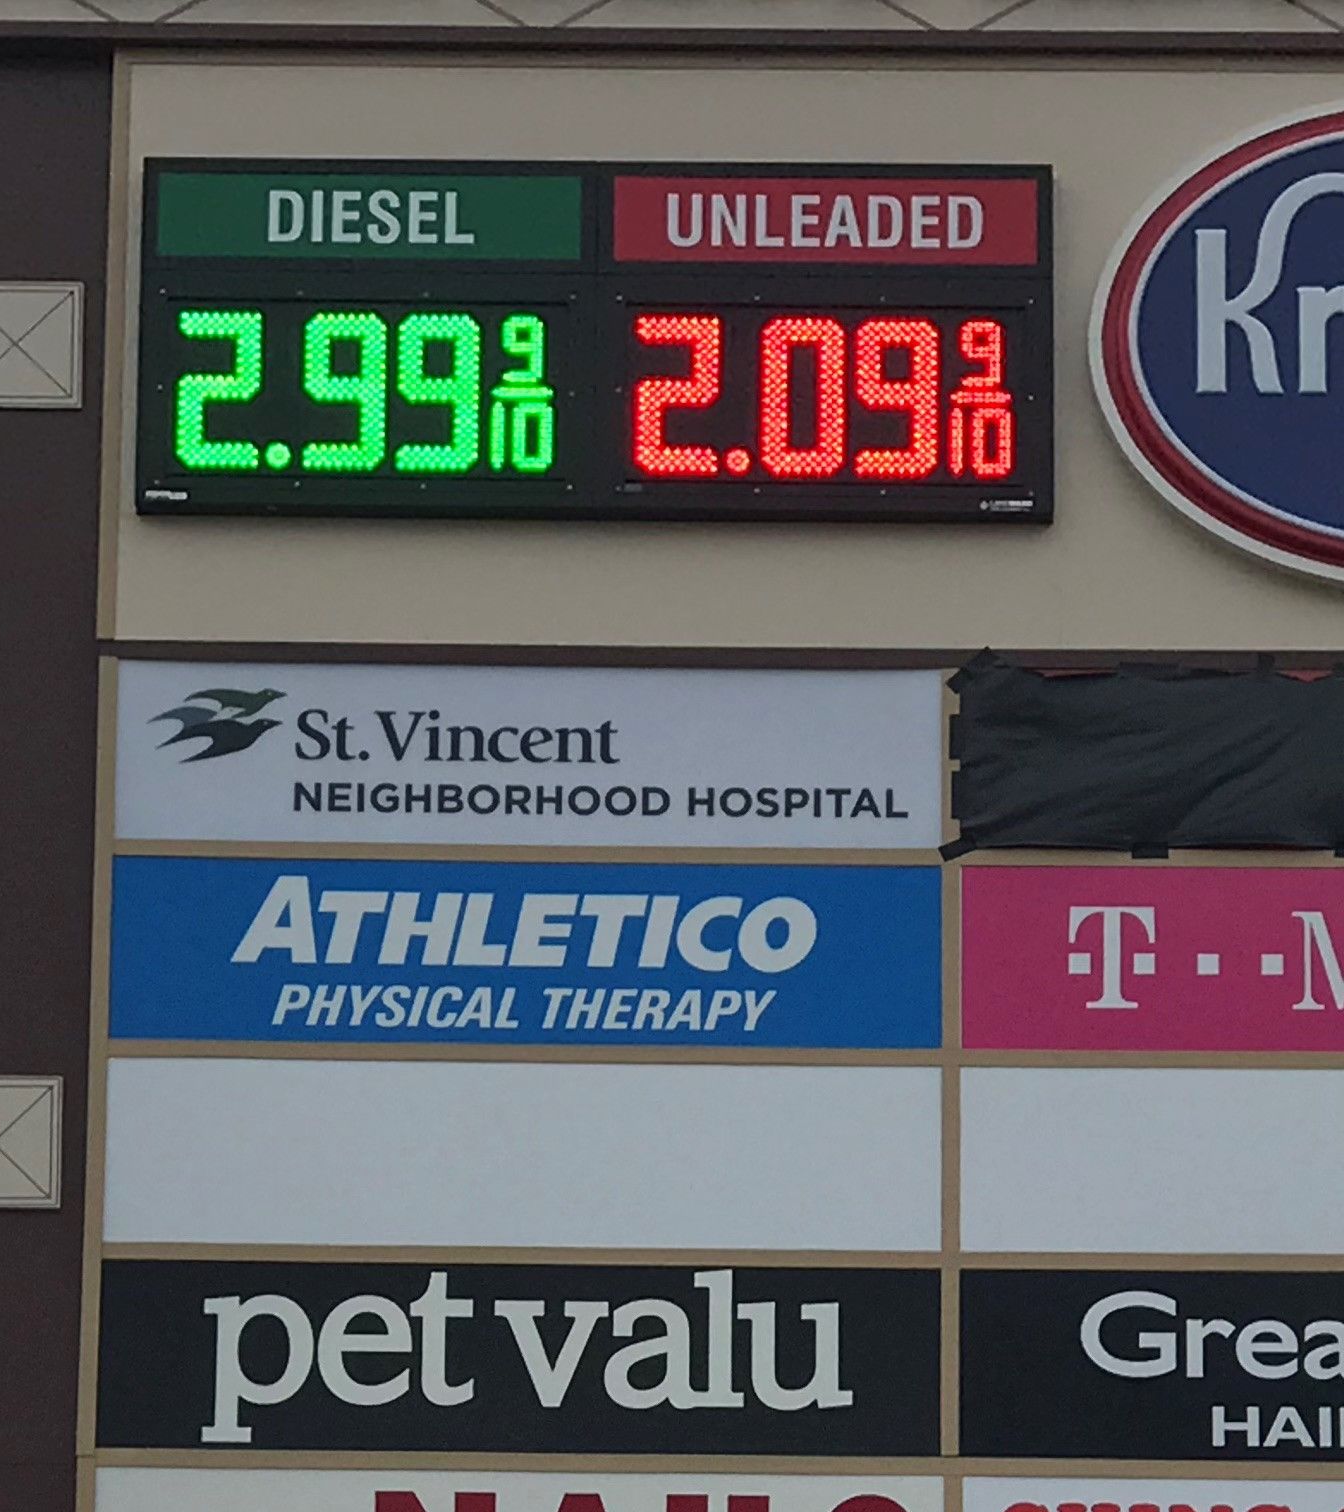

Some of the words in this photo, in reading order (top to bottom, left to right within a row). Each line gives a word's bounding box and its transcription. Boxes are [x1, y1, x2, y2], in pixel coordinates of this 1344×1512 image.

[267, 189, 475, 244] DIESEL
[666, 193, 984, 249] UNLEADED
[176, 312, 480, 471] 2.99
[634, 316, 939, 478] 2.09
[295, 709, 369, 768] St.
[374, 710, 620, 764] Vincent
[294, 782, 670, 816] NEIGHBORHOOD
[688, 787, 908, 818] HOSPITAL
[231, 876, 817, 972] ATHLETICO
[272, 985, 518, 1028] PHYSICAL
[542, 988, 776, 1030] THERAPY
[200, 1270, 475, 1443] pet
[494, 1269, 854, 1411] valu
